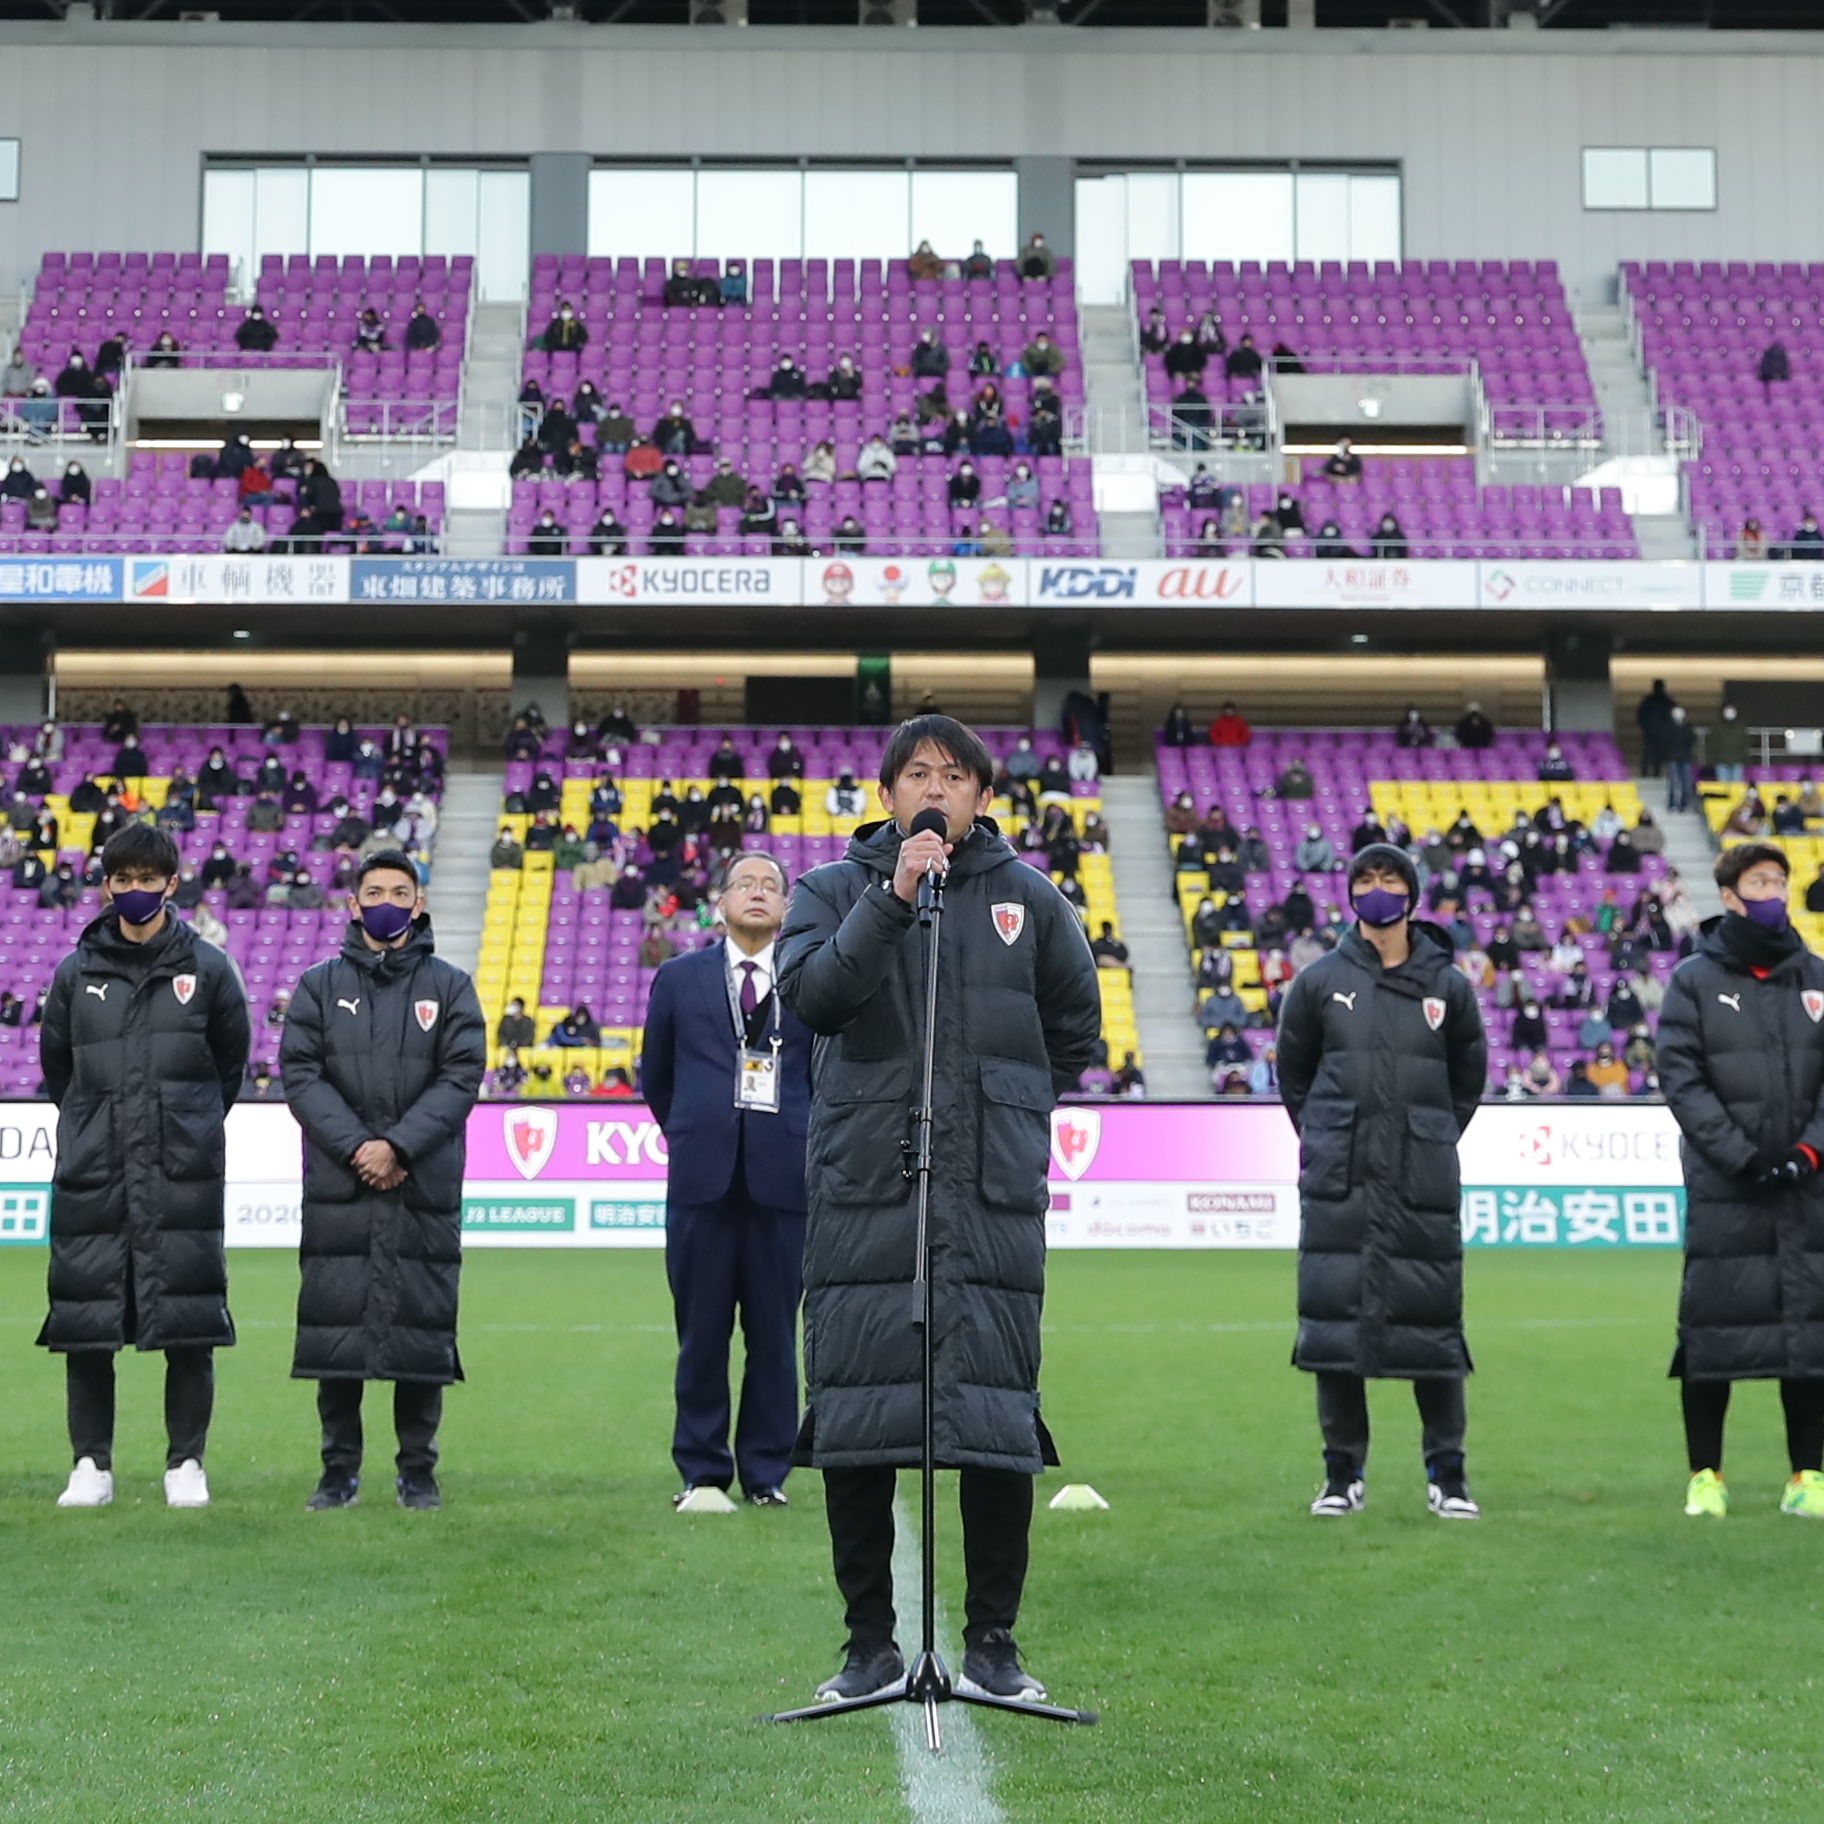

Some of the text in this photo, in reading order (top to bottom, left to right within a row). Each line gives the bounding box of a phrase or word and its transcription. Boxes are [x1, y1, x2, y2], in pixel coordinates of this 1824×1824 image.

[362, 574, 566, 599] 東畑建築事務所
[643, 568, 771, 594] KYOCERA
[1039, 567, 1138, 599] KDDI
[1156, 567, 1243, 599] au
[1524, 568, 1624, 593] CONNECT
[1562, 1132, 1684, 1162] KYOCE
[488, 1206, 567, 1224] LEAGUE
